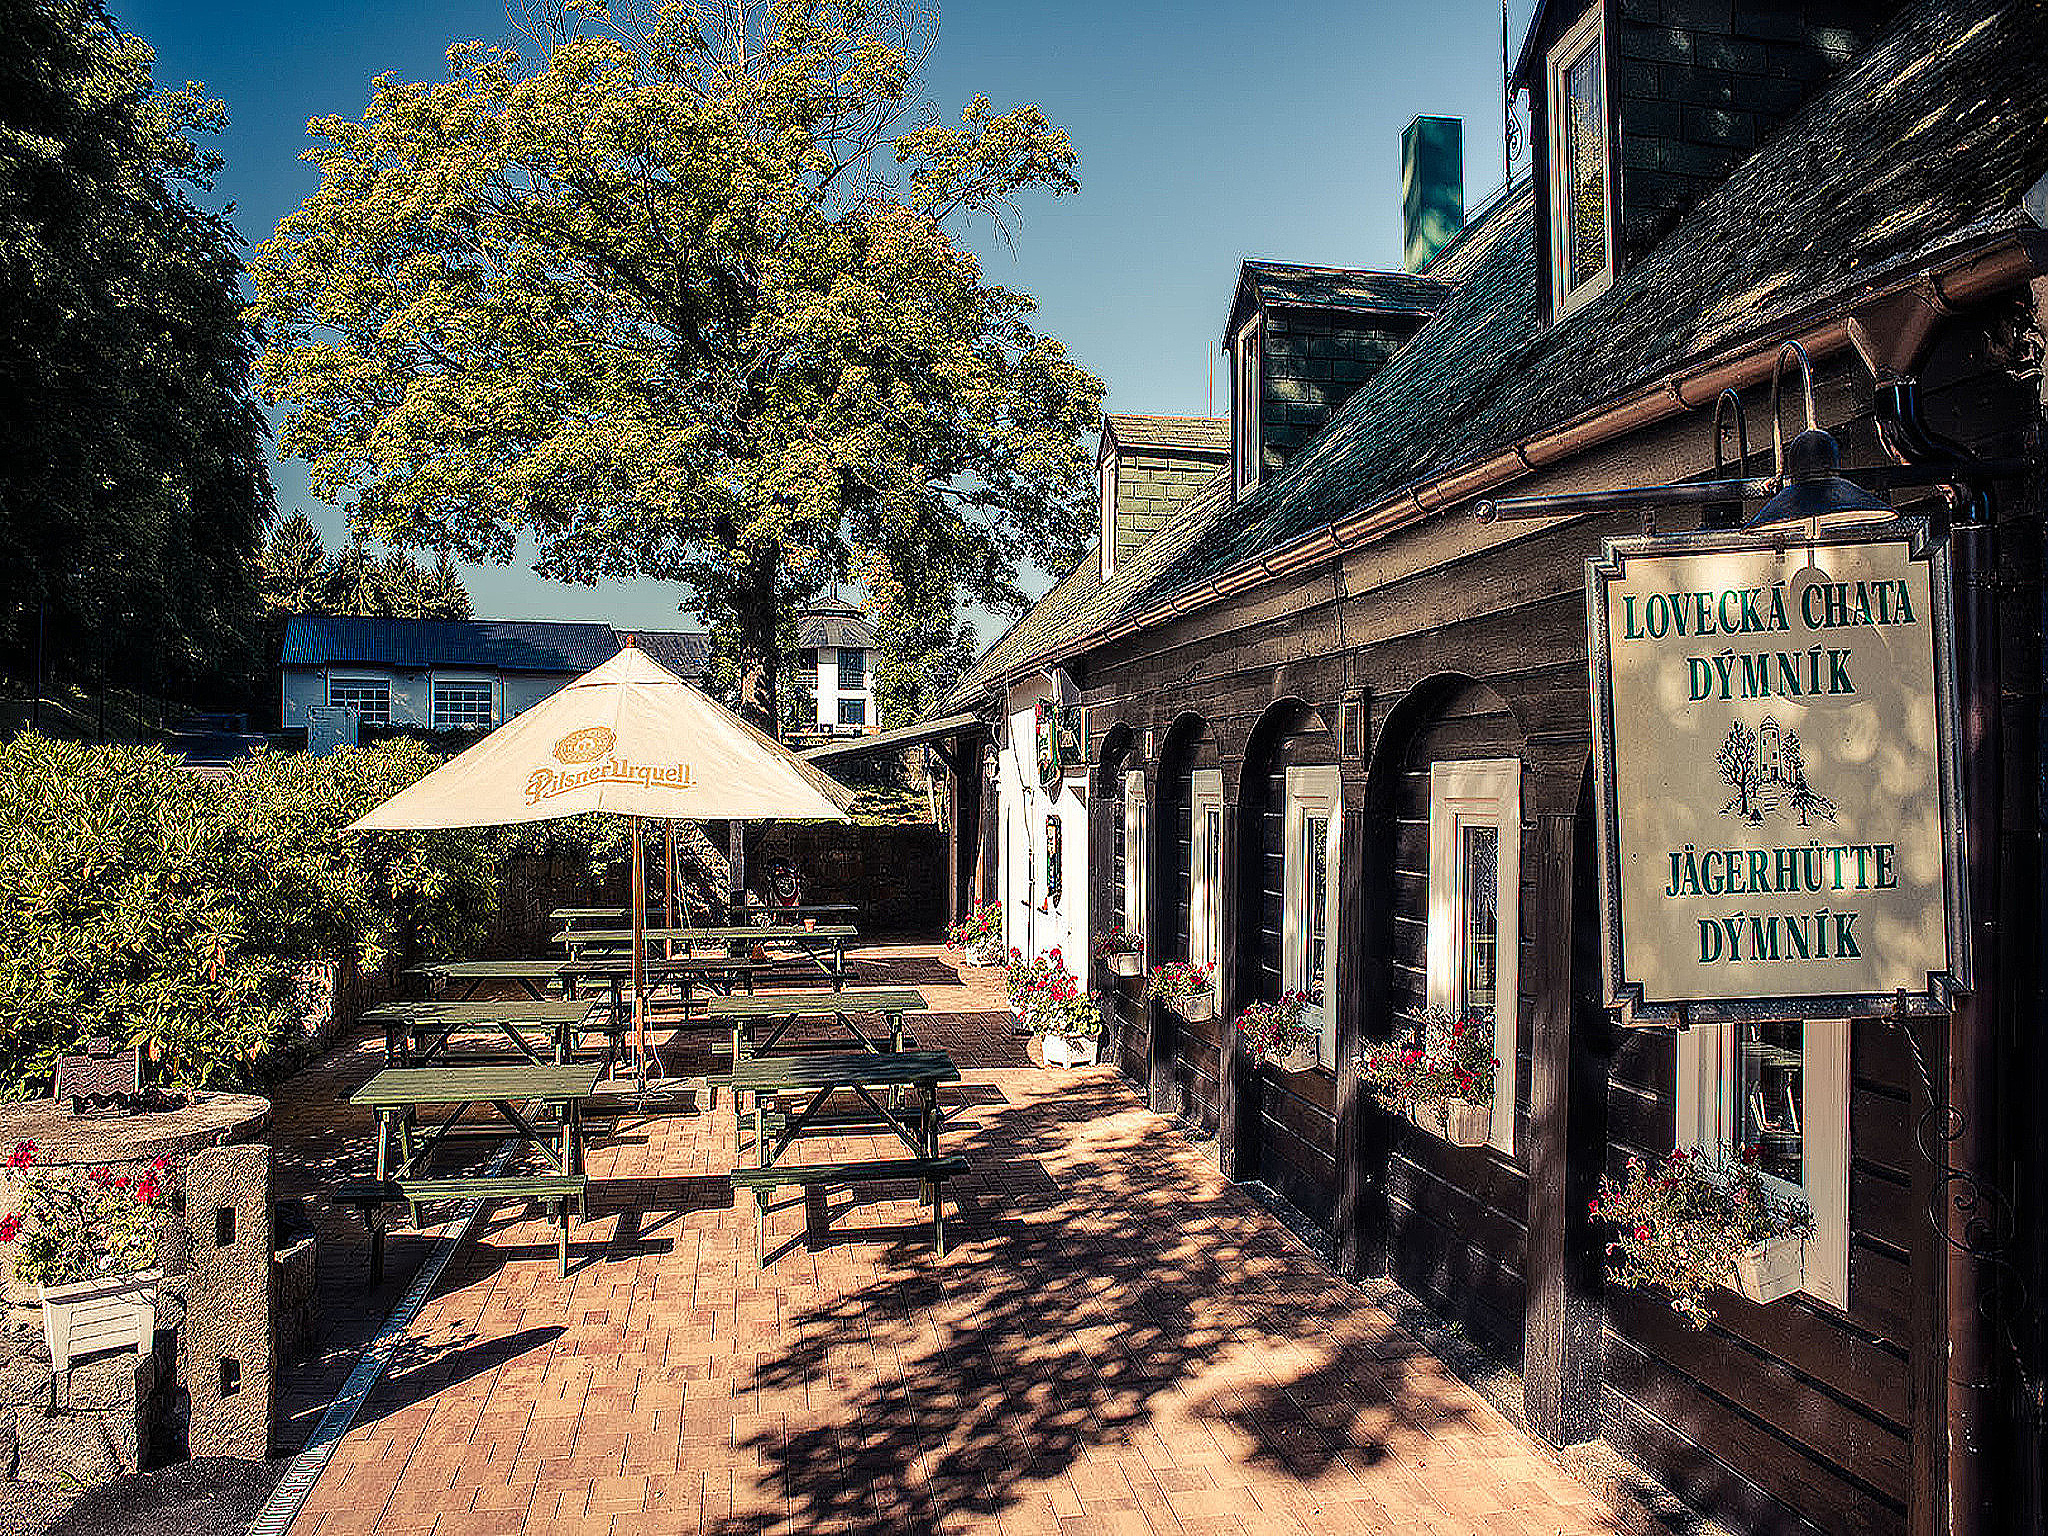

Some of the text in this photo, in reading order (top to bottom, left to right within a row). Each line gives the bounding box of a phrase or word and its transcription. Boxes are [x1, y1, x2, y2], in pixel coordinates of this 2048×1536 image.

[1625, 580, 1916, 640] LOVECKÁ CHATA
[1688, 646, 1856, 701] DÝMNÍK
[525, 757, 689, 806] Pilsner Urquell
[1666, 842, 1898, 897] JÄGERHÜTTE
[1697, 911, 1862, 963] DÝMNÍK
